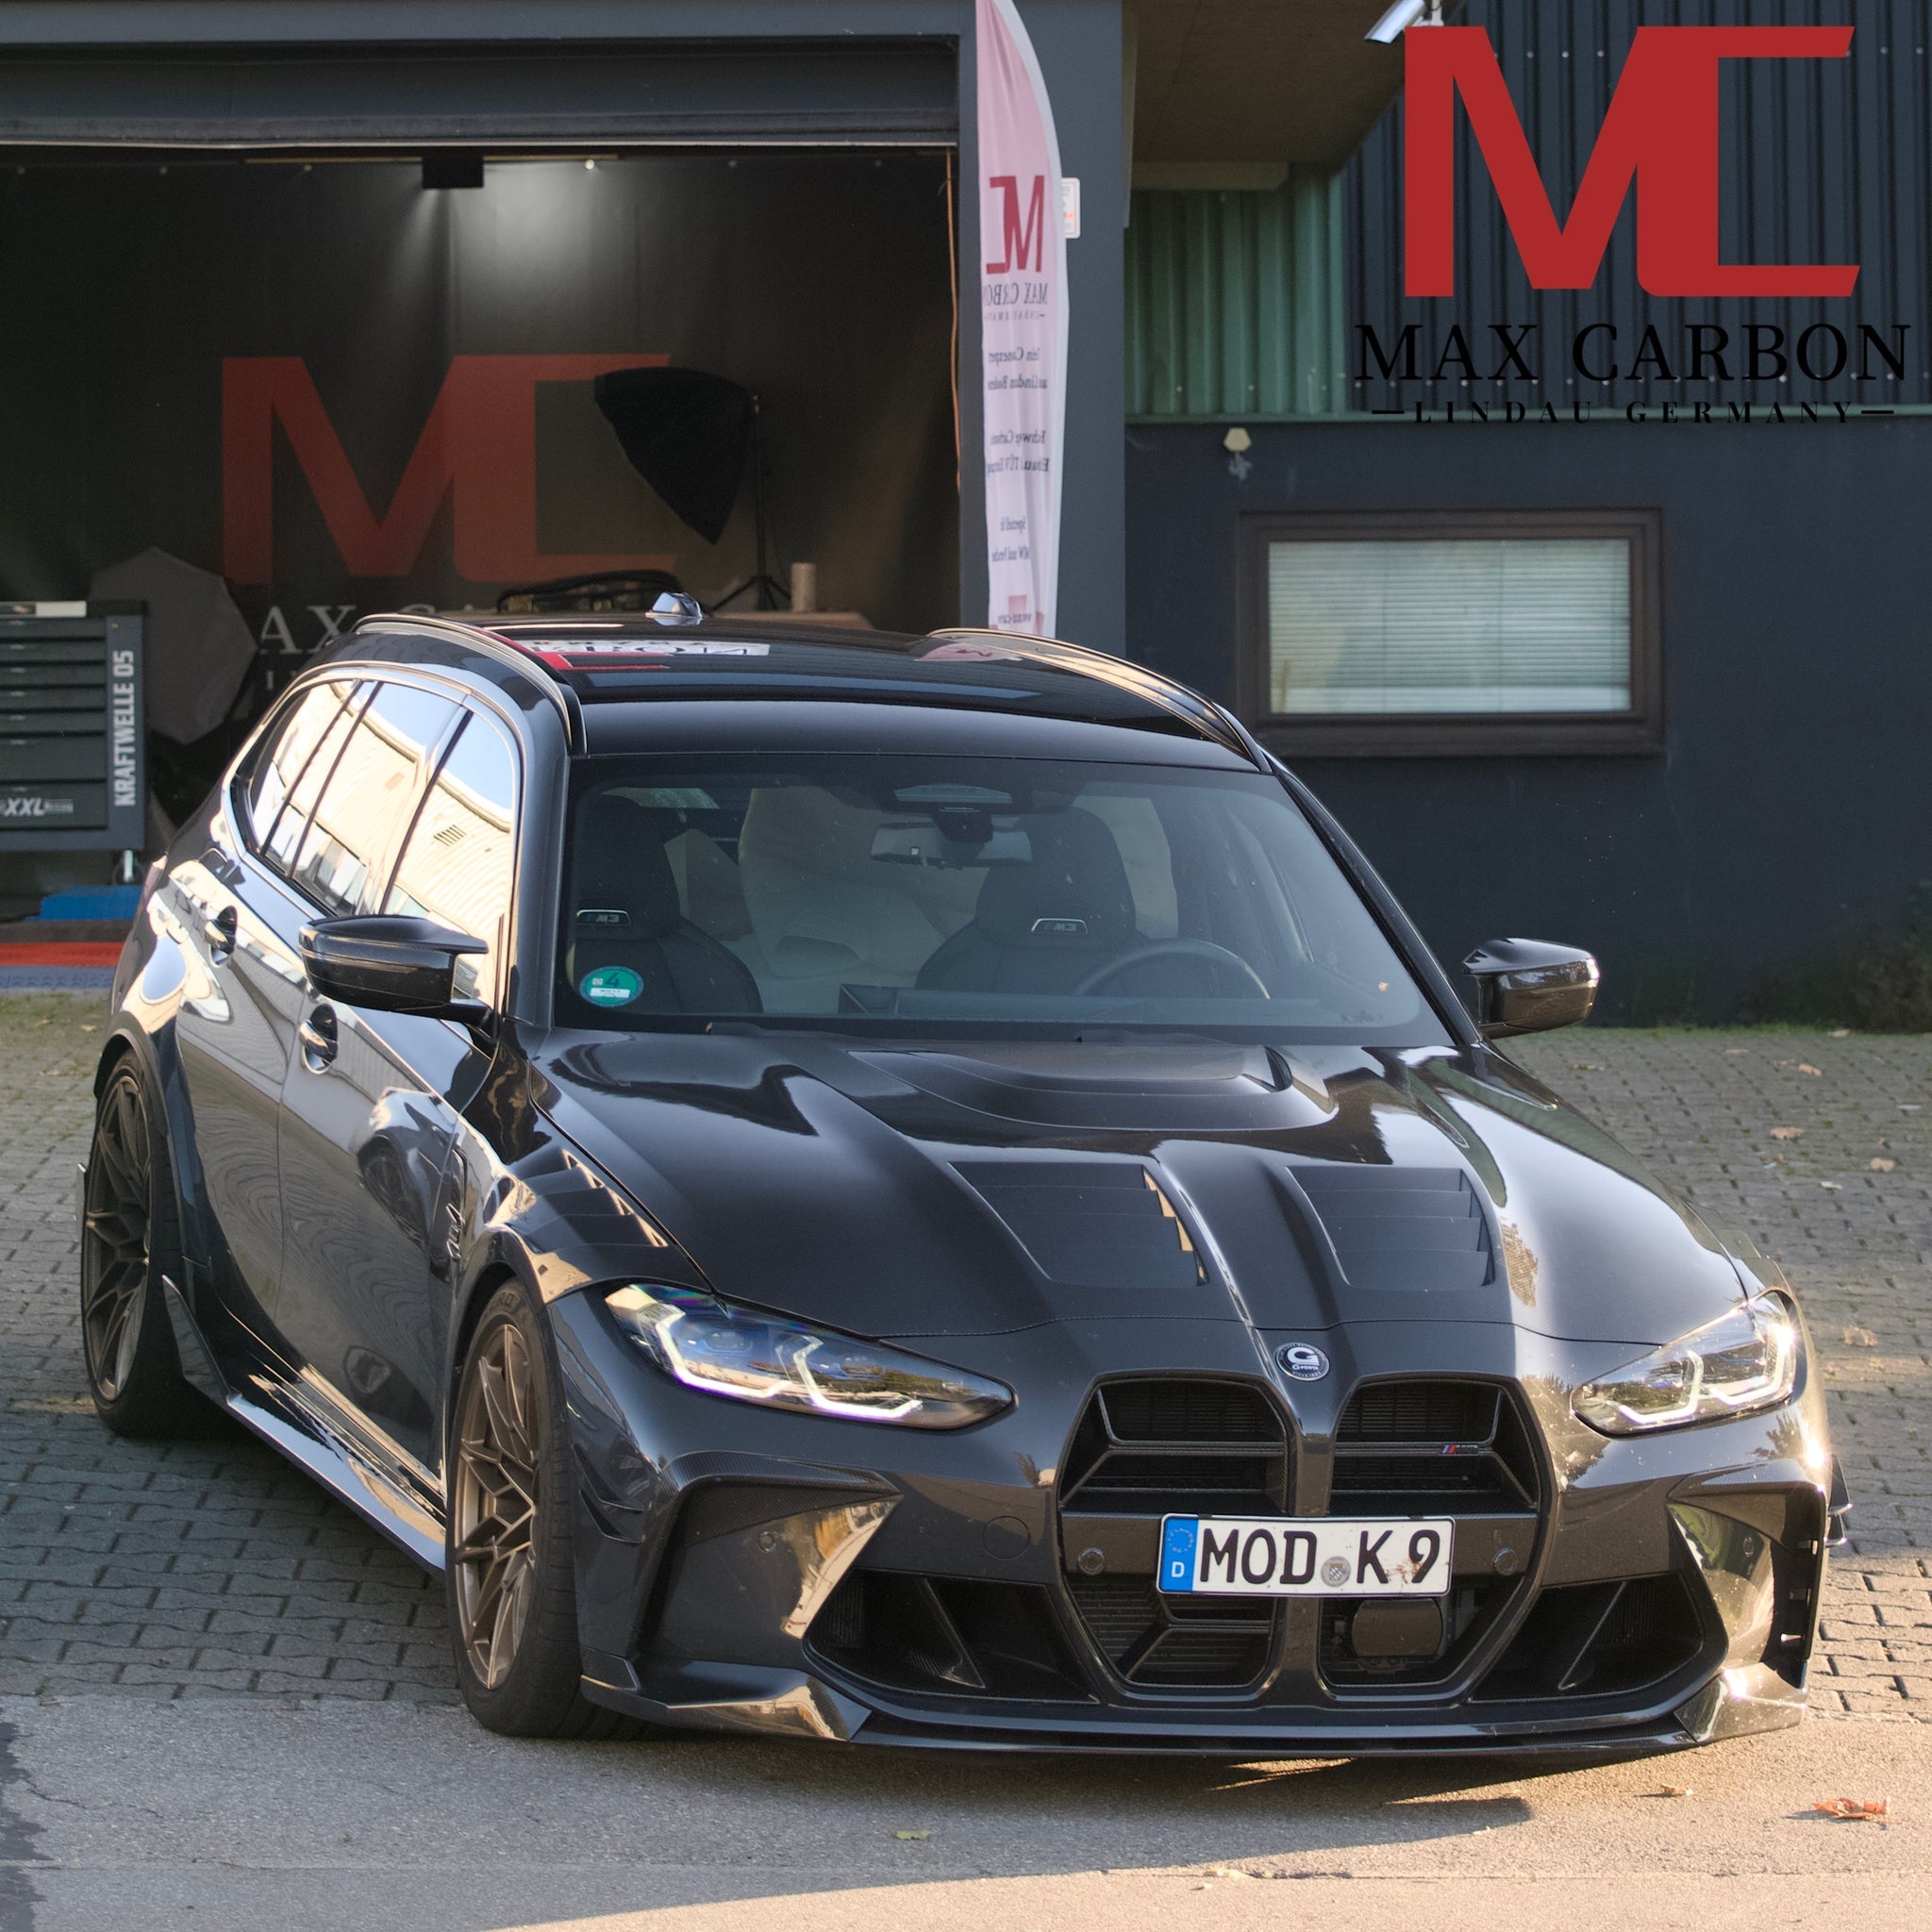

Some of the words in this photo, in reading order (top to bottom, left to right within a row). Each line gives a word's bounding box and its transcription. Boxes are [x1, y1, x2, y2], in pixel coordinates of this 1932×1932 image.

[258, 605, 357, 655] AX
[112, 682, 136, 807] KRAFTWELLE
[3, 797, 44, 816] XXL
[605, 971, 621, 989] 4
[1171, 1561, 1185, 1578] D
[1199, 1527, 1318, 1585] MOD
[1356, 1529, 1394, 1585] K
[1407, 1529, 1441, 1584] 9
